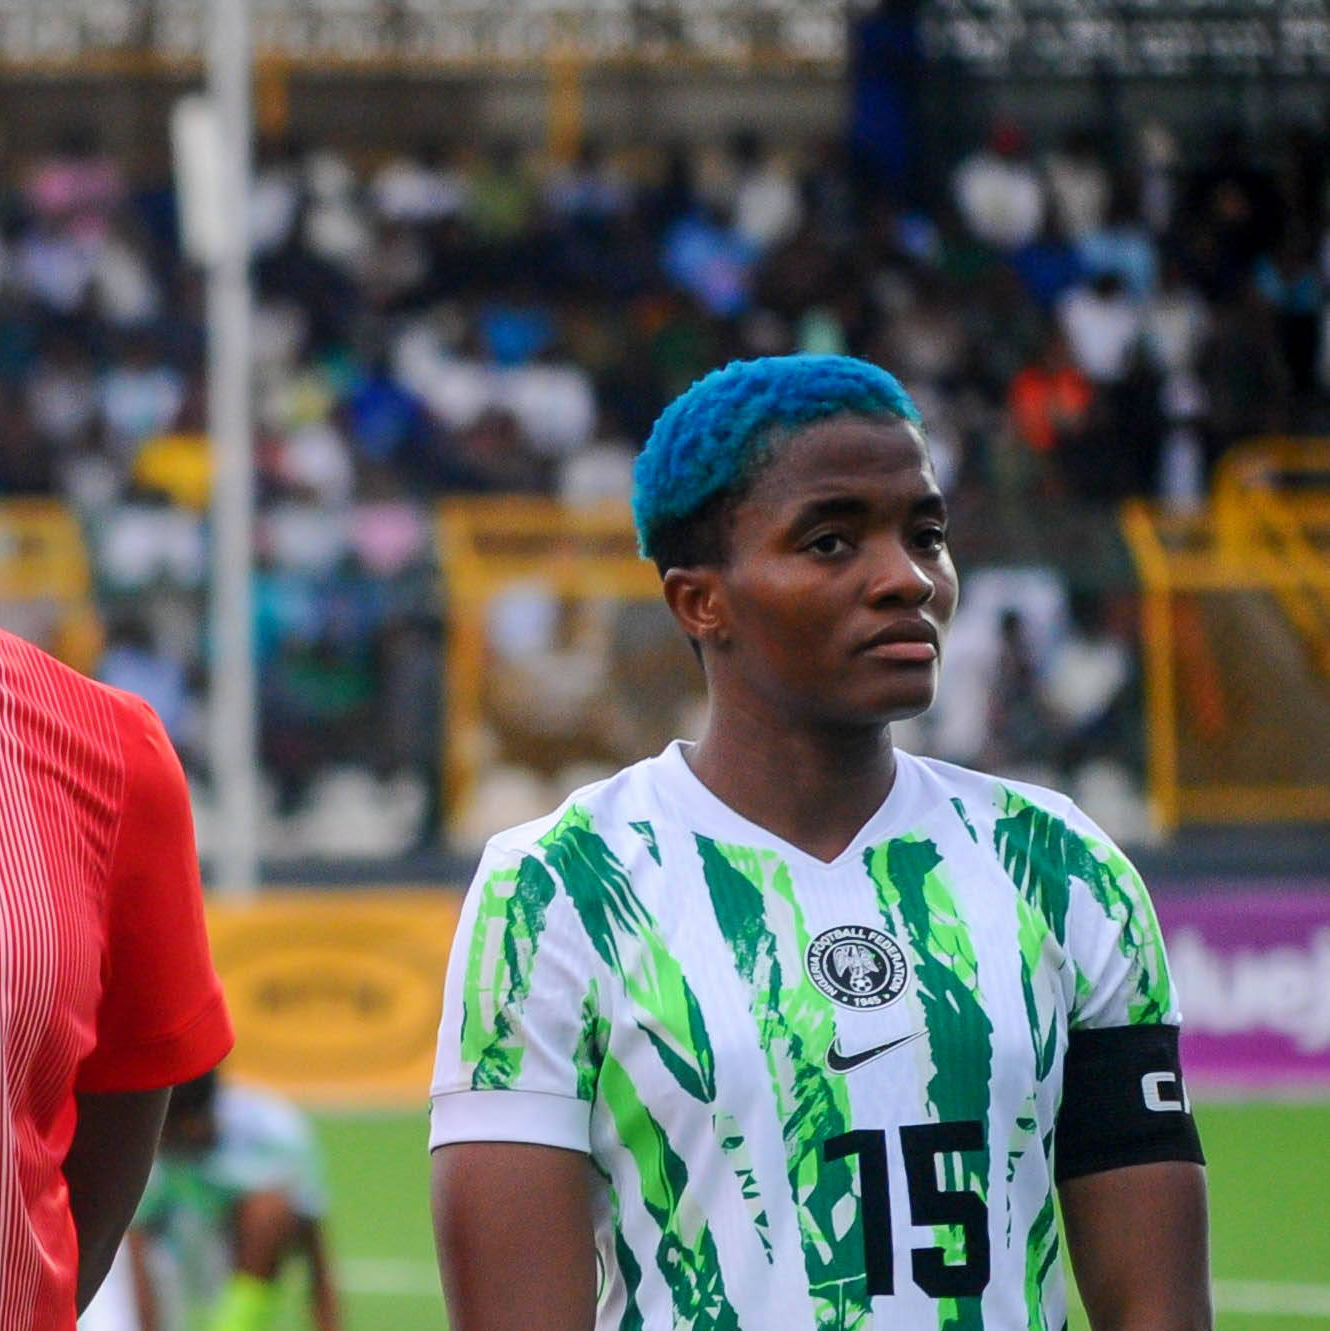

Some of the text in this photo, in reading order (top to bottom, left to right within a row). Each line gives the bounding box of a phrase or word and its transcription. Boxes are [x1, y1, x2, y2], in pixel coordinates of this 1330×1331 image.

[810, 928, 905, 996] NIGERIA FOOTBALL FEDERATION
[854, 996, 881, 1007] 1945
[1141, 1071, 1191, 1114] C
[824, 1120, 990, 1298] 15
